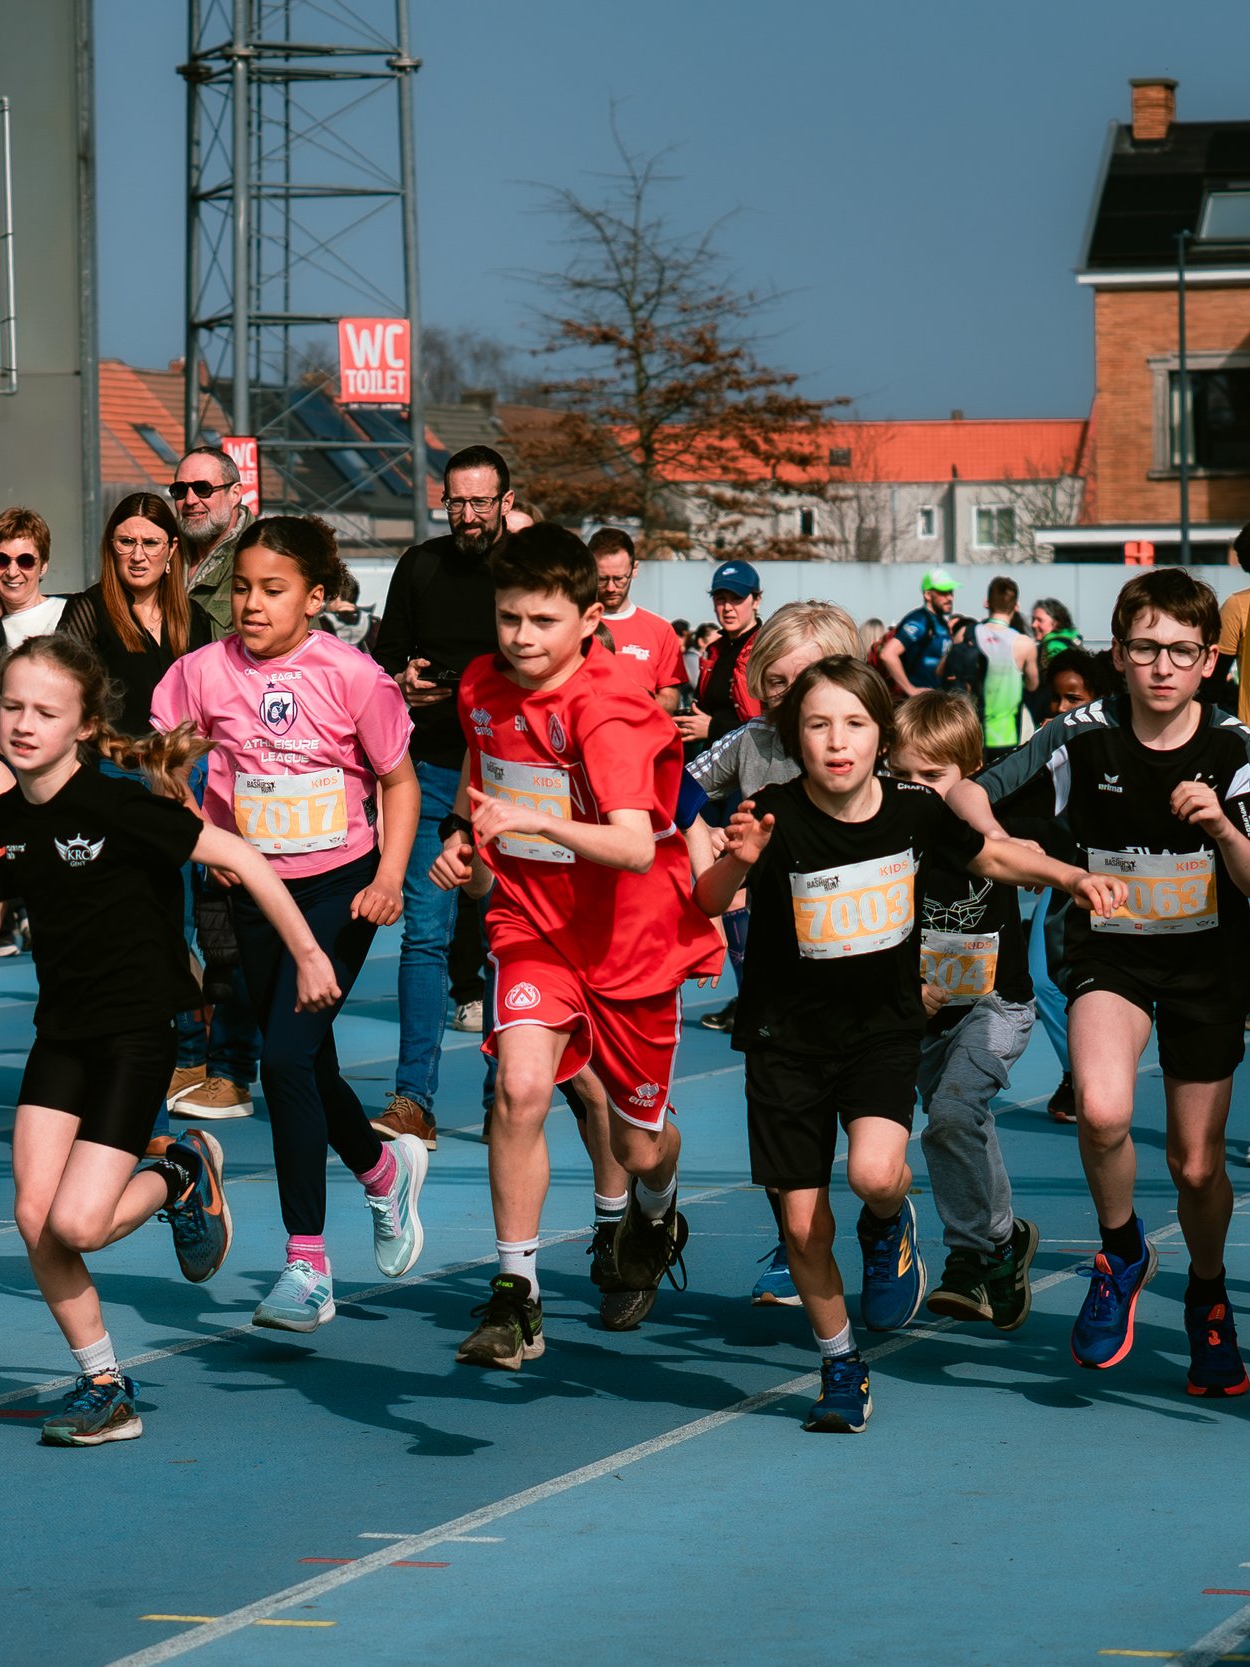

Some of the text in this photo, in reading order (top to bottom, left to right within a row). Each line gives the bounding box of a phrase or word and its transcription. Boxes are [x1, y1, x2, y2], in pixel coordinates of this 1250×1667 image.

[345, 324, 405, 368] WC
[346, 369, 406, 395] TOILET
[228, 443, 255, 467] WC
[242, 738, 320, 750] ATHLEISURE
[261, 751, 310, 764] LEAGUE
[311, 775, 339, 789] KIDS
[533, 775, 563, 789] KIDS
[1098, 783, 1124, 793] erima
[240, 794, 339, 836] 7017
[67, 849, 90, 860] KRC
[879, 861, 910, 877] KIDS
[1176, 860, 1208, 872] KIDS
[800, 882, 910, 940] 7003
[963, 941, 992, 950] KIDS
